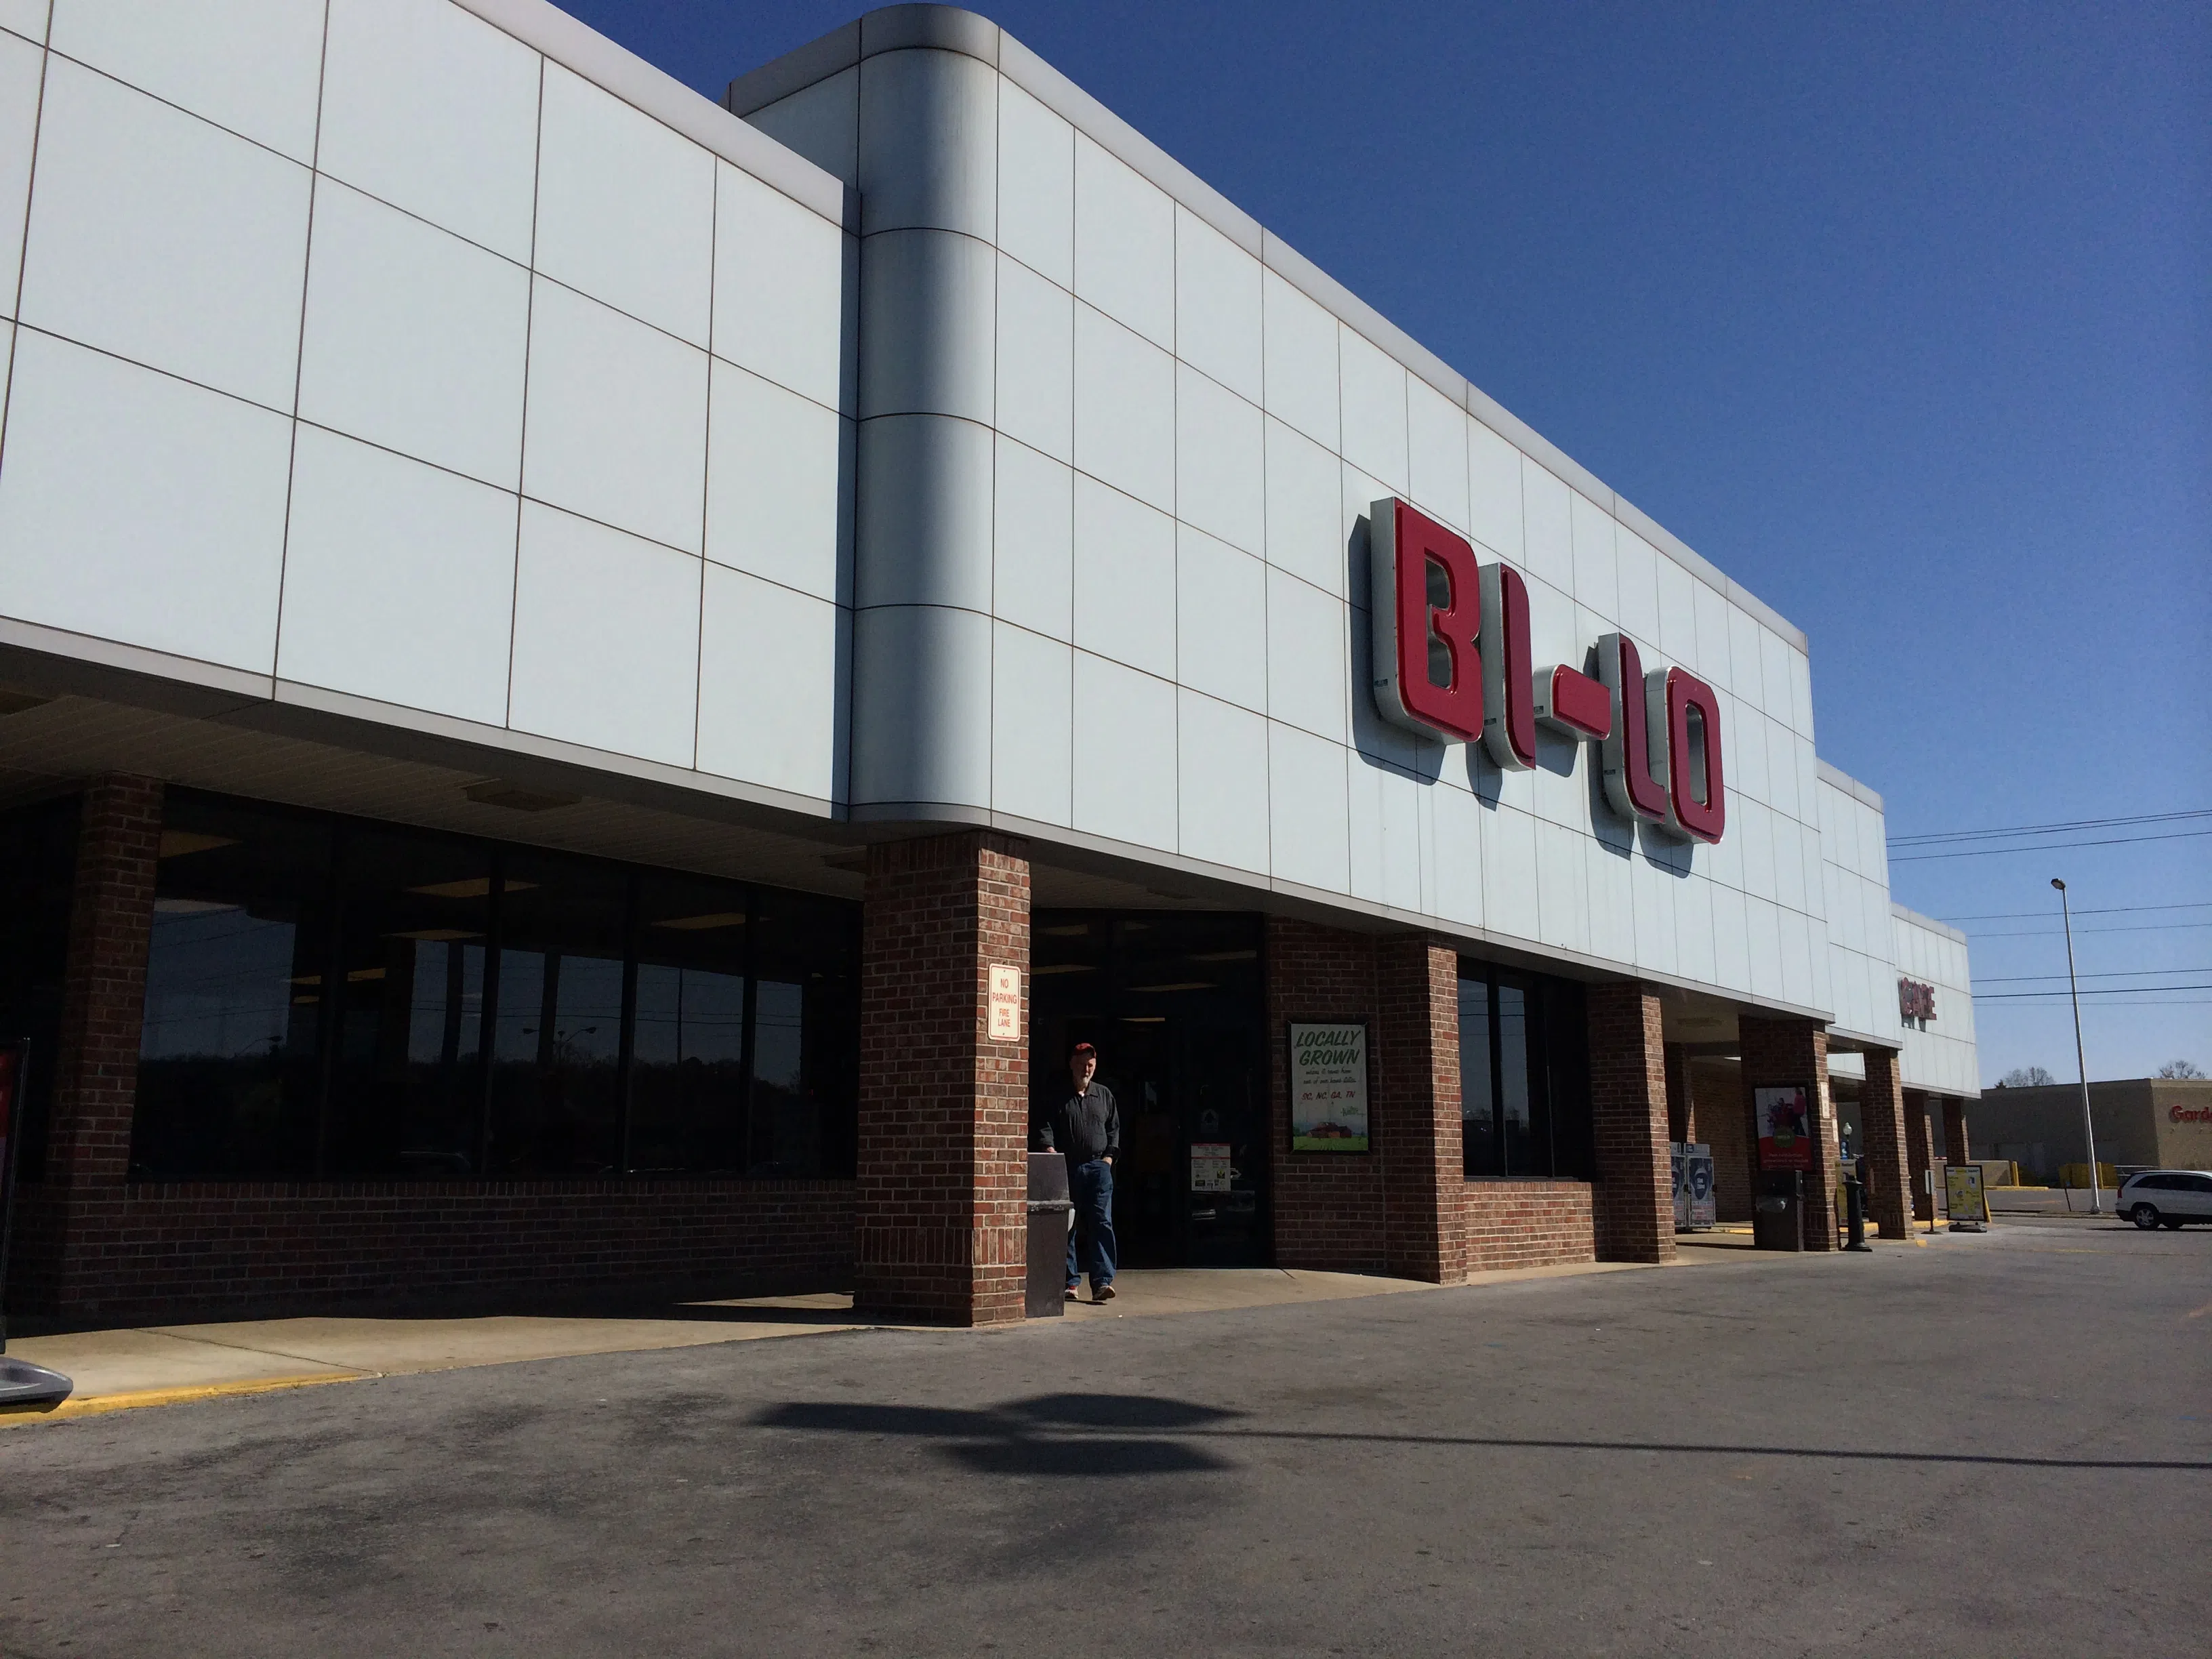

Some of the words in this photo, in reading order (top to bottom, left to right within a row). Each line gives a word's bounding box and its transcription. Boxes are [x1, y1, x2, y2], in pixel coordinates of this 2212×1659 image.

[1371, 497, 1725, 844] BI-LO
[1000, 979, 1008, 988] NO
[992, 992, 1017, 1004] PARKING
[999, 1008, 1009, 1017] FIRE
[998, 1019, 1010, 1027] LANE
[1296, 1030, 1361, 1046] LOCALLY
[1299, 1049, 1360, 1065] GROWN
[2171, 1105, 2212, 1122] Gard
